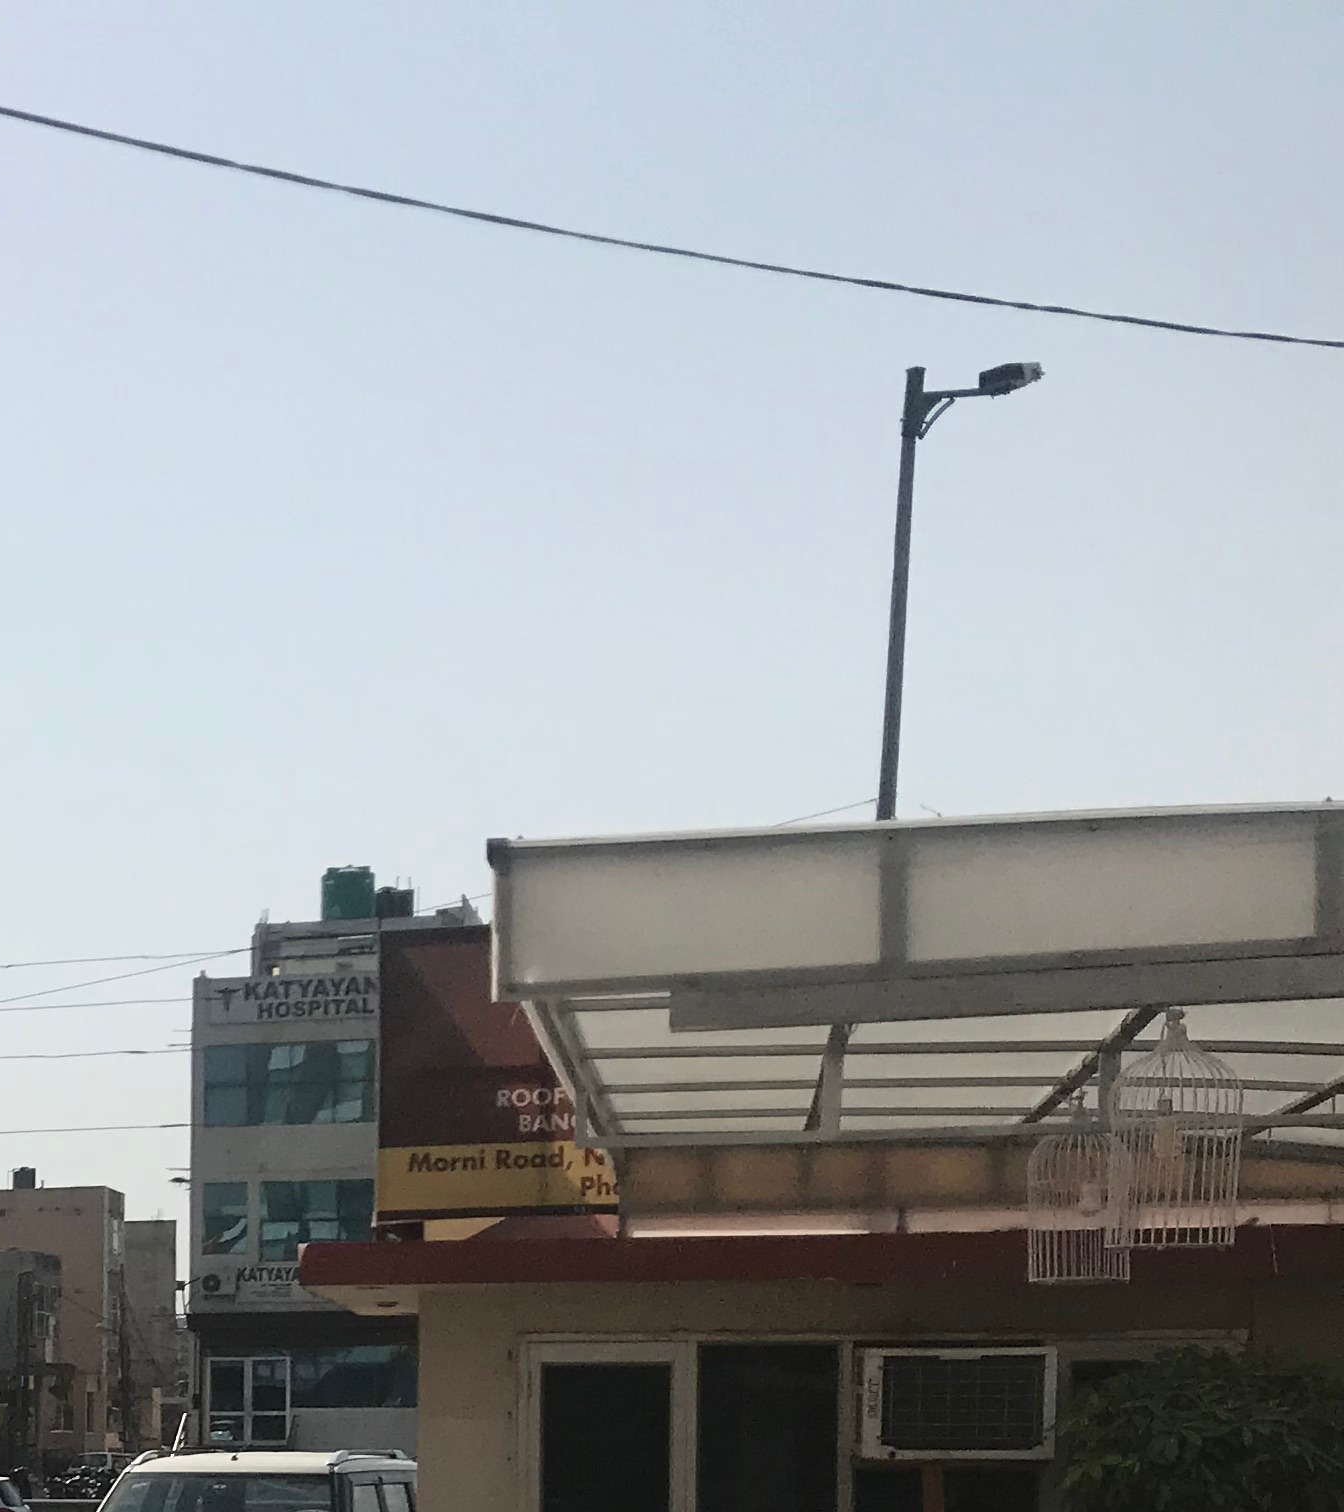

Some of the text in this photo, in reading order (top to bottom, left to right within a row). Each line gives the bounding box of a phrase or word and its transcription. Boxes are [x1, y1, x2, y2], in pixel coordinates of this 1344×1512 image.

[256, 996, 375, 1019] HOSPITAL
[408, 1149, 486, 1173] Morni
[496, 1145, 574, 1171] Road,
